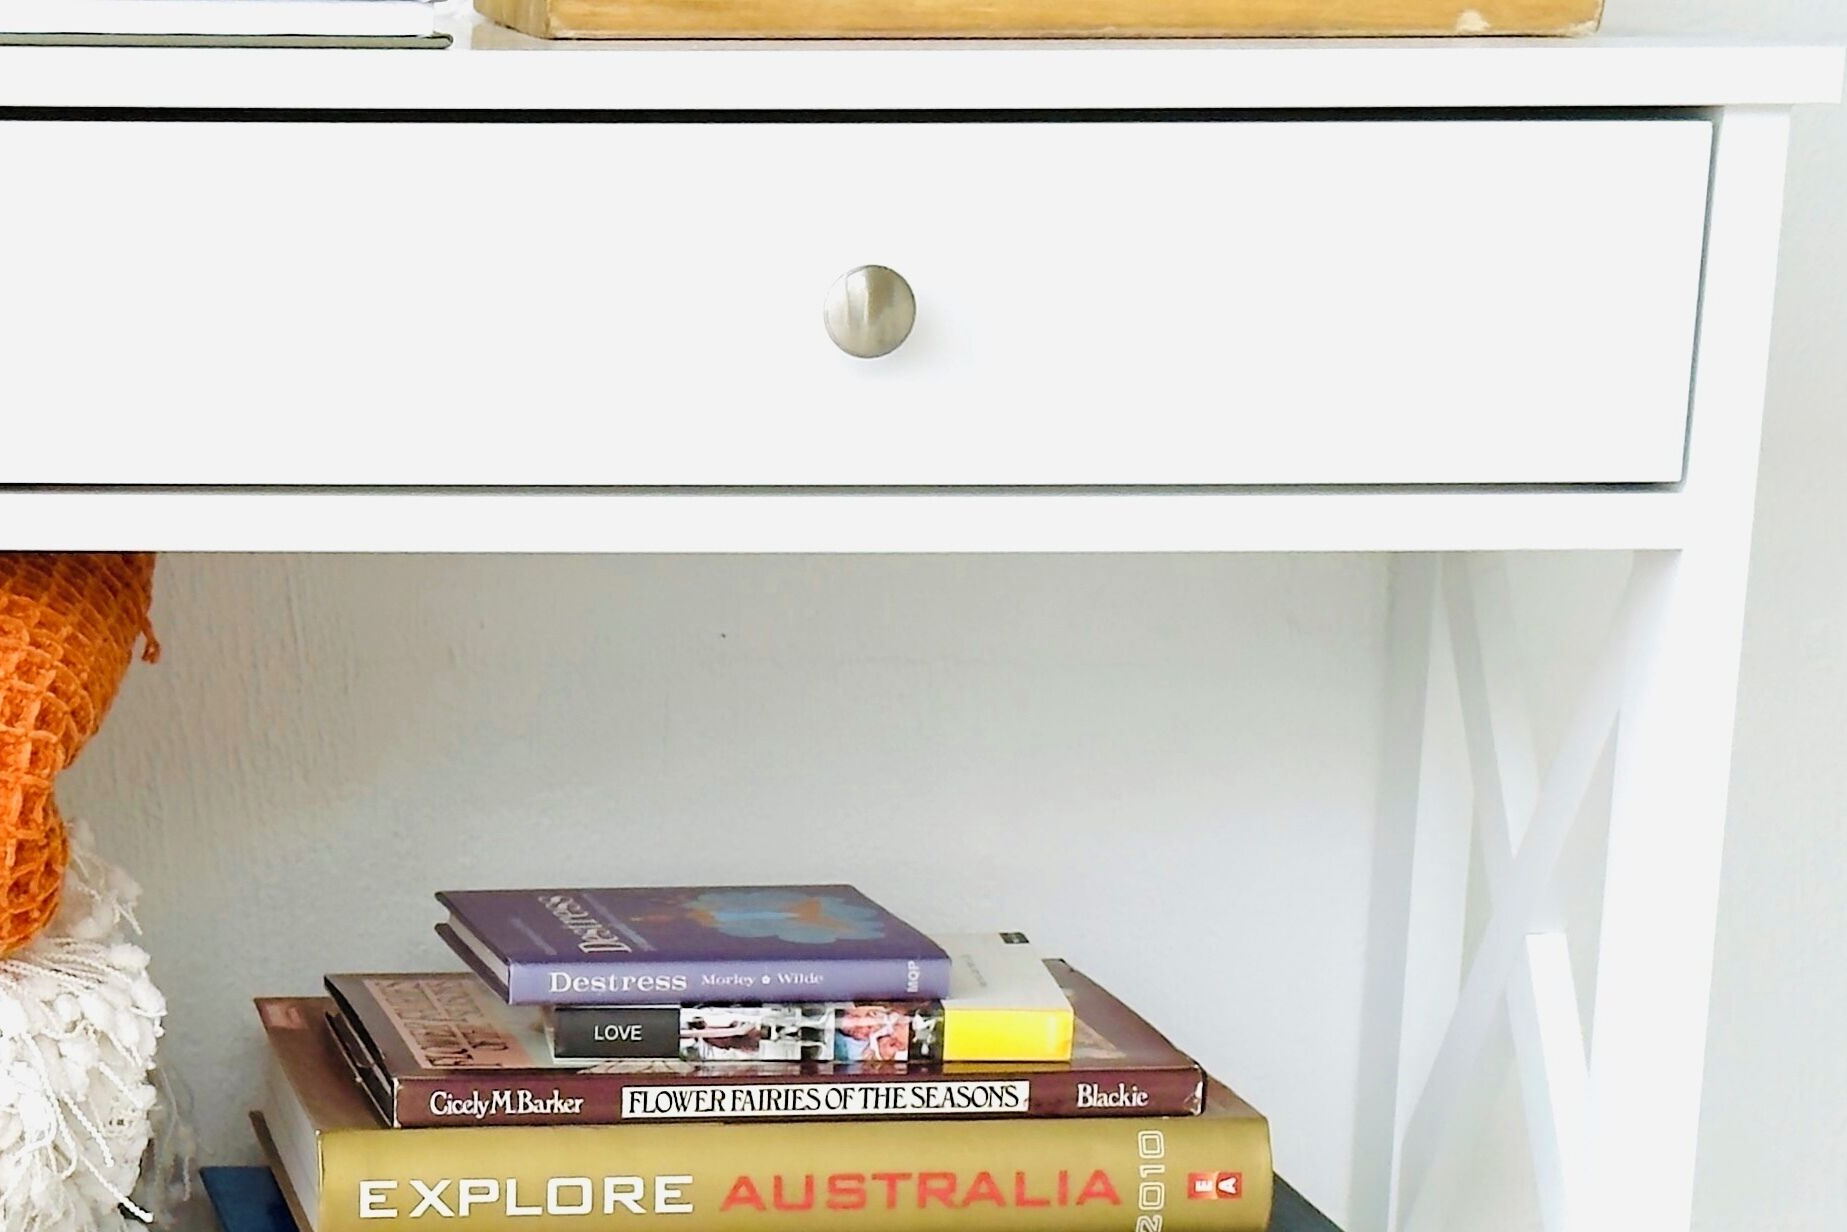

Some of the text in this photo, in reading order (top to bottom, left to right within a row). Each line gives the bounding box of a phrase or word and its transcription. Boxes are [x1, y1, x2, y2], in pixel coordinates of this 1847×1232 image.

[548, 970, 825, 993] Destress Morley Wilde
[907, 960, 921, 993] MQP
[593, 1024, 644, 1042] LOVE
[430, 1091, 490, 1119] Cicely
[516, 1089, 584, 1115] Barker
[628, 1085, 1020, 1115] FLOWER FAIRIES OF THE SEASONS
[1076, 1083, 1149, 1109] Blackie
[358, 1169, 1122, 1218] EXPLORE AUSTRALIA
